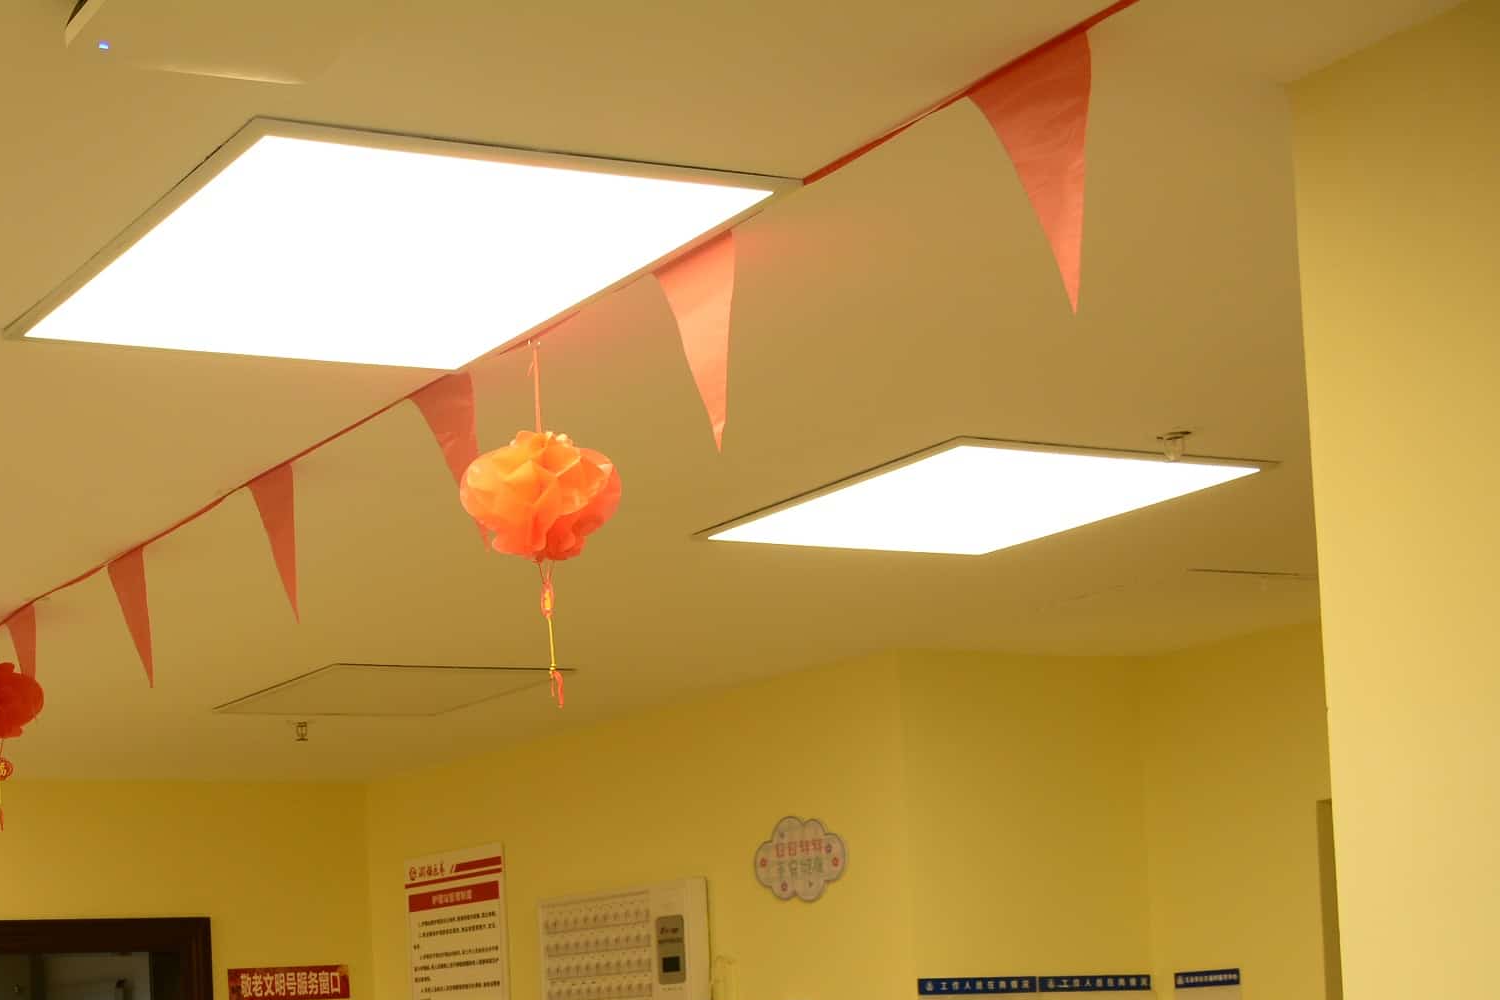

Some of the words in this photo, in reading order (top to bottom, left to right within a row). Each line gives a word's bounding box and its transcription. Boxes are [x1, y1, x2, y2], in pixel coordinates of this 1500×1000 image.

[240, 971, 341, 998] 敬老文明号服务窗口
